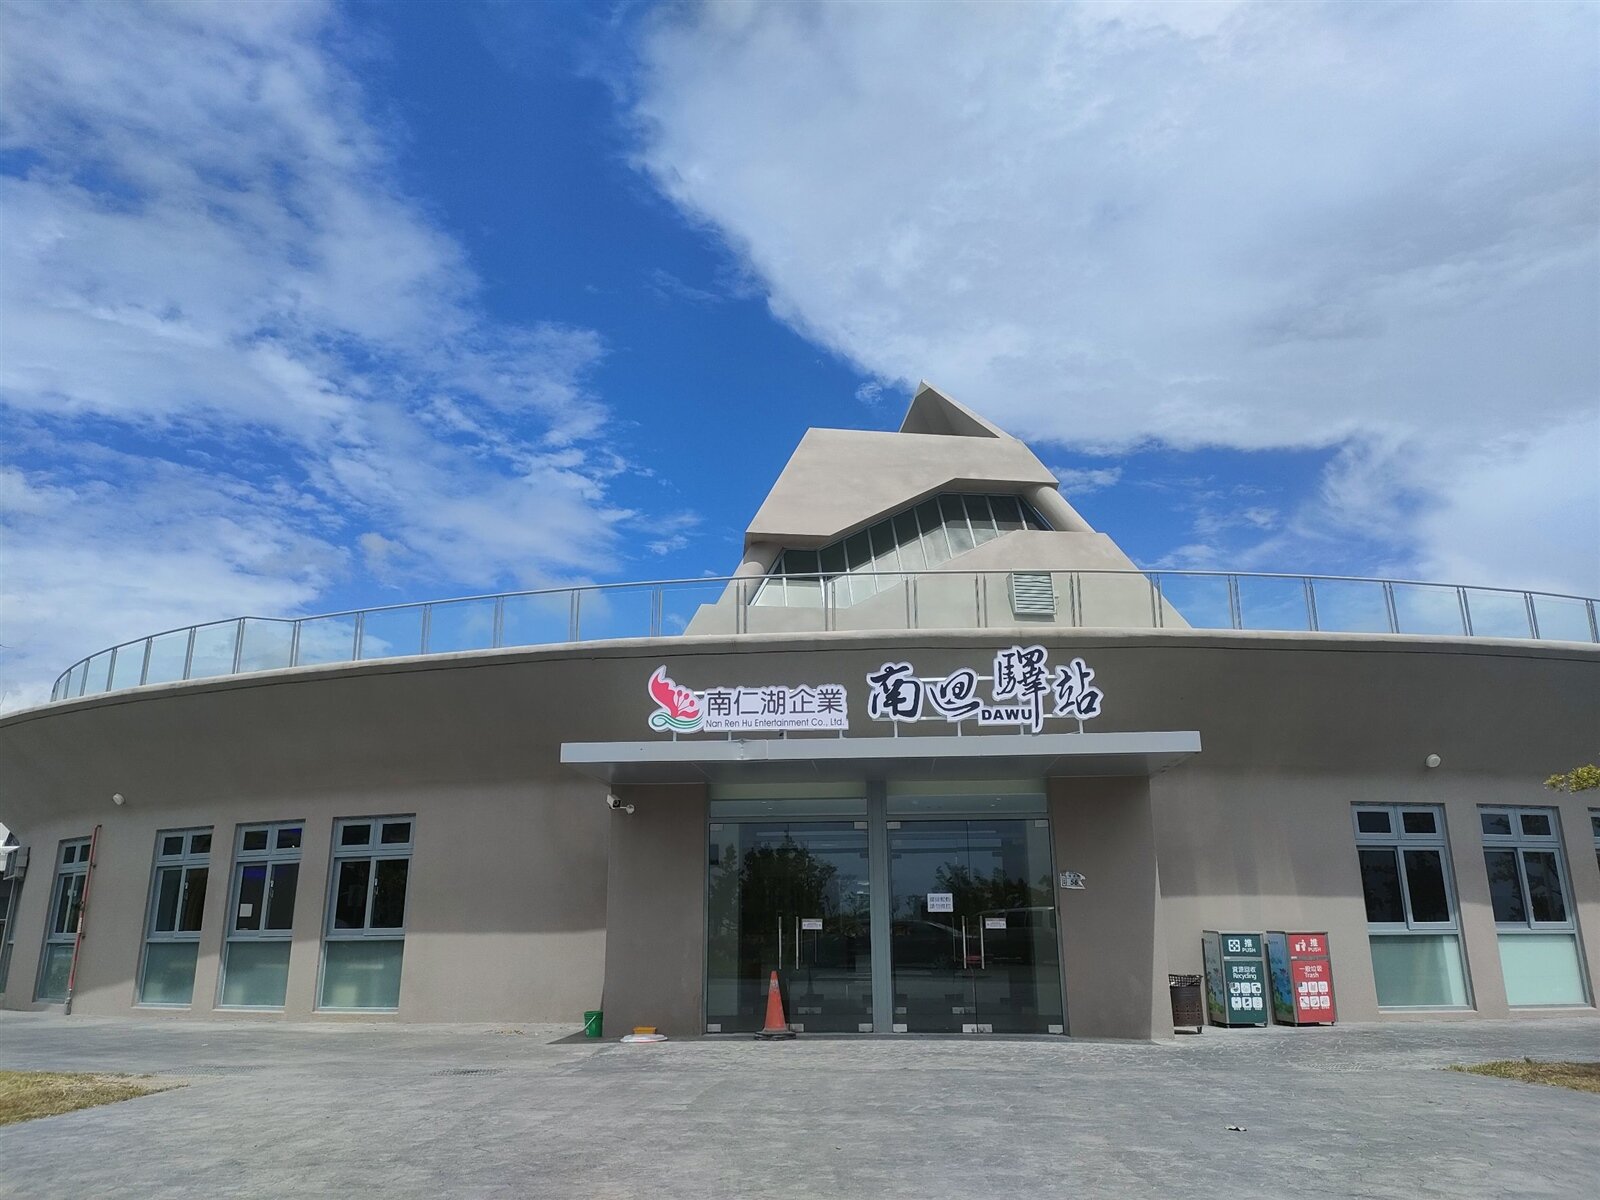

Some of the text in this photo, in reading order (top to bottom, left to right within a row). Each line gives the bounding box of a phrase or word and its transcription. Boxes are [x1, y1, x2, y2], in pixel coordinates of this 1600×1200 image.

[707, 688, 844, 716] 南仁湖企業
[981, 708, 1032, 721] DAWU
[705, 717, 845, 728] Nan Ren Hu Entertainment Co., Ltd.
[1232, 972, 1257, 980] Recycling
